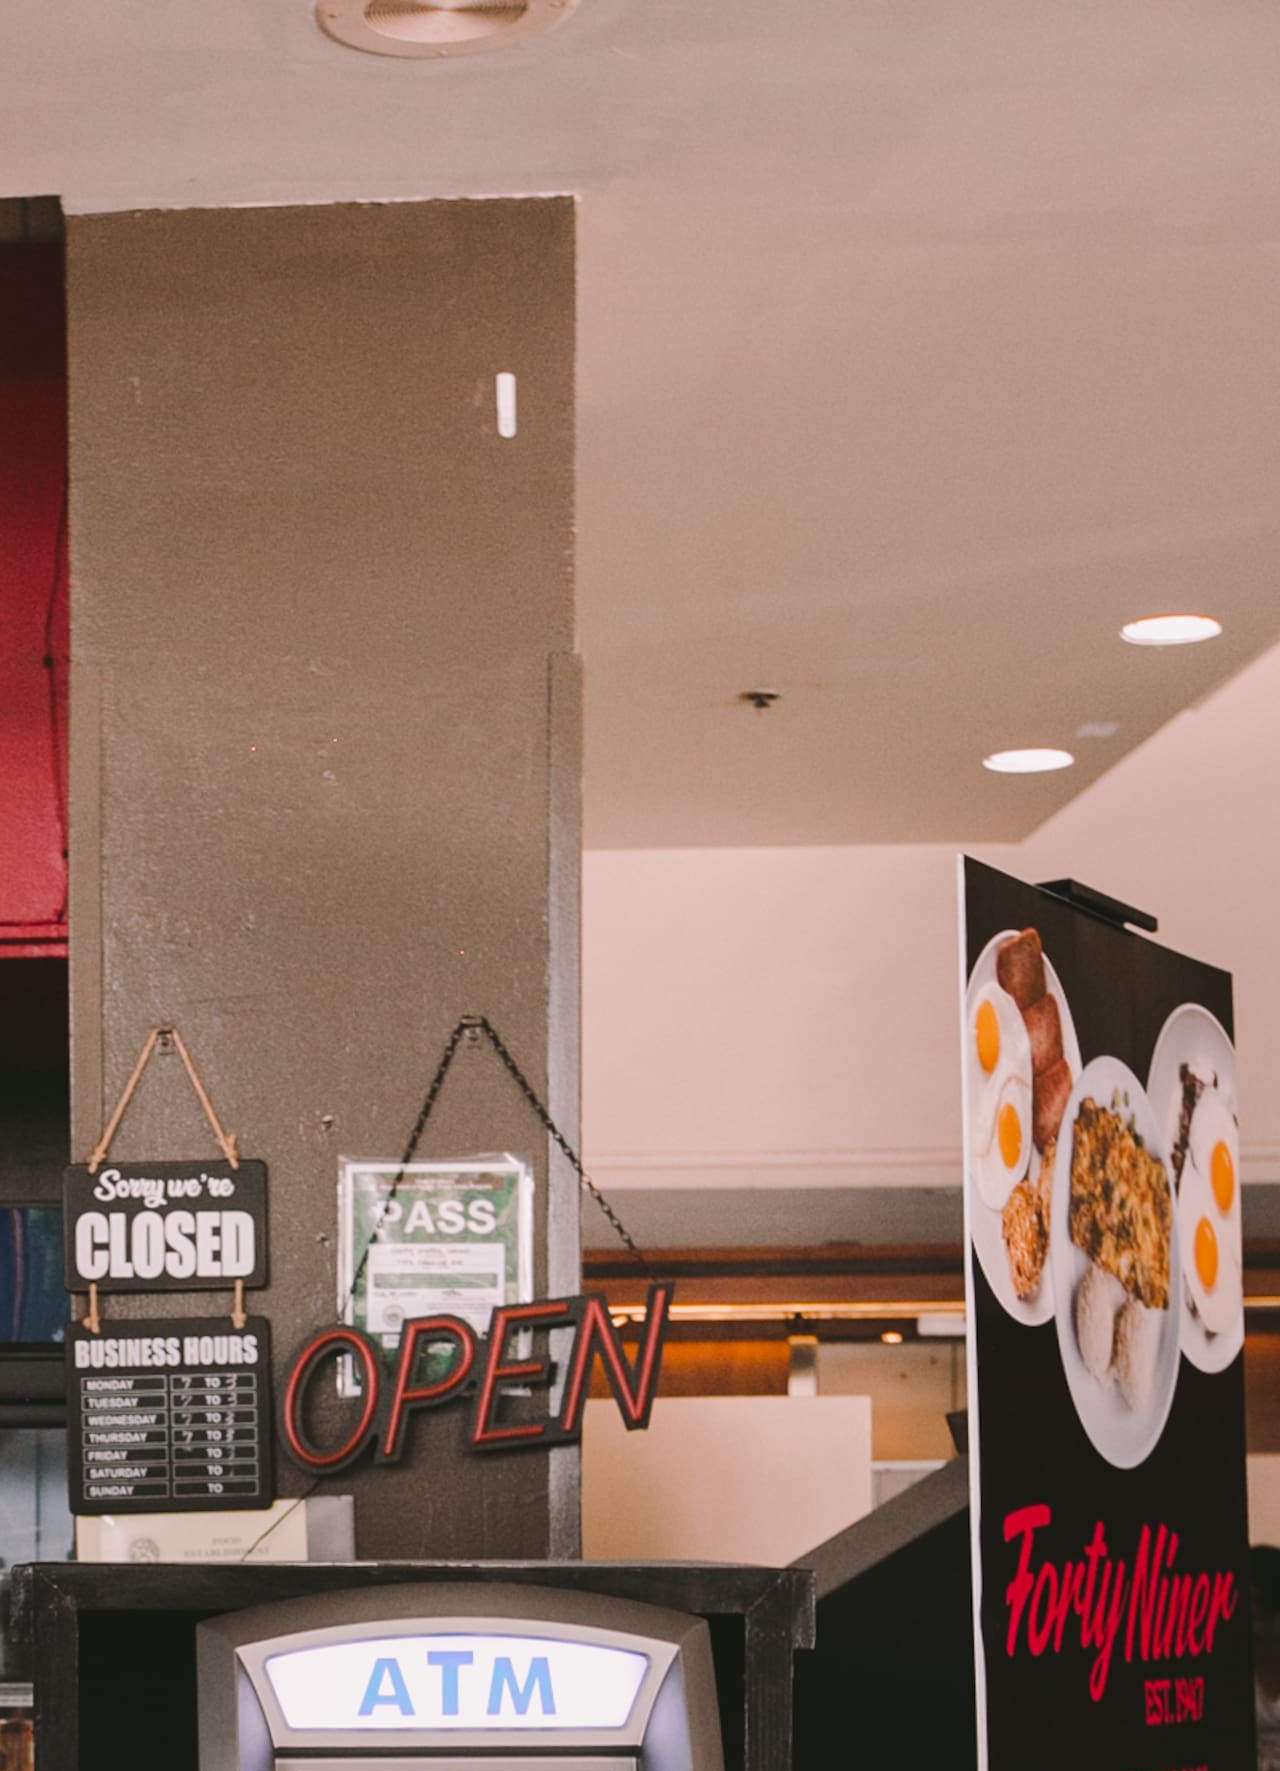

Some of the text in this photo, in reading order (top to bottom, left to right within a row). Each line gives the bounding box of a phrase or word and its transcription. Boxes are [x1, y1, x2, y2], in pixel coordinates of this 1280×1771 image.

[93, 1169, 235, 1208] Sorry we're
[374, 1199, 497, 1235] PASS
[75, 1210, 255, 1279] CLOSED
[74, 1335, 259, 1368] BUSINESS HOURS
[205, 1377, 220, 1387] TO
[282, 1284, 671, 1470] OPEN
[86, 1380, 134, 1391] MONDAY
[87, 1397, 138, 1409] TUESDAY
[205, 1395, 221, 1405] TO
[87, 1415, 157, 1426] WEDNESDAY
[205, 1413, 221, 1423] TO
[89, 1433, 148, 1444] THURSDAY
[206, 1430, 221, 1441] TO
[88, 1450, 128, 1461] FRIDAY
[207, 1448, 222, 1458] TO
[89, 1468, 148, 1479] SATURDAY
[207, 1465, 223, 1476] TO
[89, 1486, 134, 1497] SUNDAY
[208, 1483, 223, 1493] TO
[1004, 1504, 1237, 1702] Forty Niner
[358, 1650, 556, 1716] ATM
